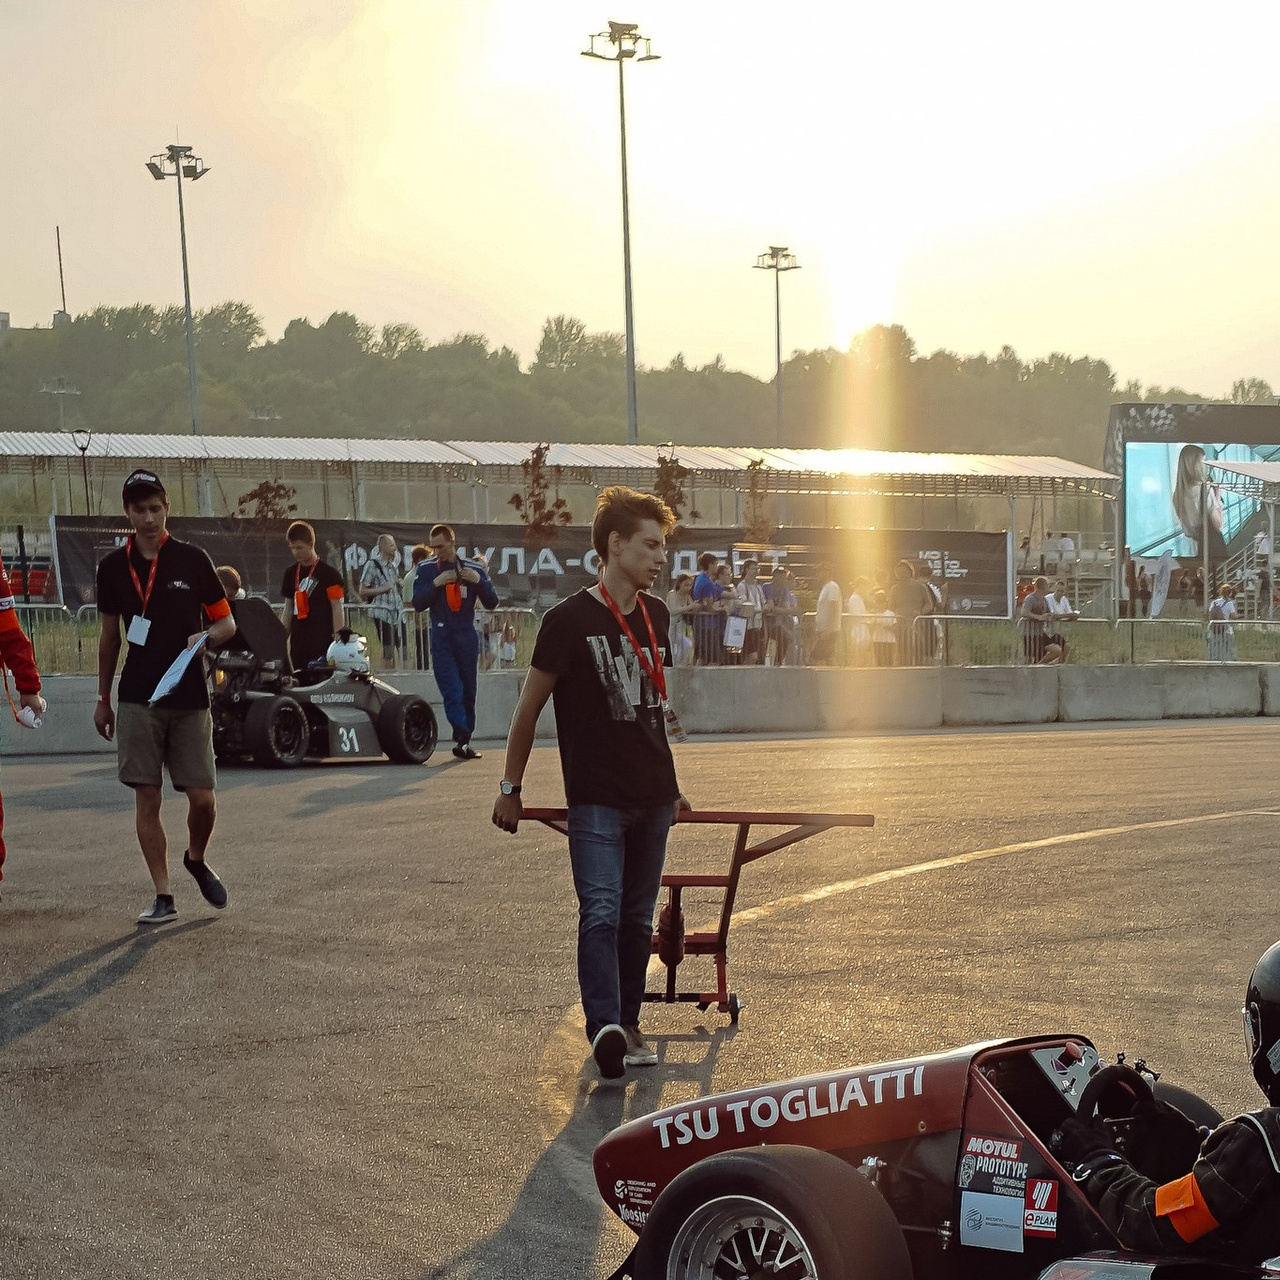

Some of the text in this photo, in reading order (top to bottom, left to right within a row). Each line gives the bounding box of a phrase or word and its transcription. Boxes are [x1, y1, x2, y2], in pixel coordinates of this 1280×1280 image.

[339, 727, 360, 752] 31
[652, 1065, 924, 1149] TSU TOGLIATTI
[967, 1137, 1018, 1159] MOTUL
[976, 1156, 1028, 1179] PROTOTYPE
